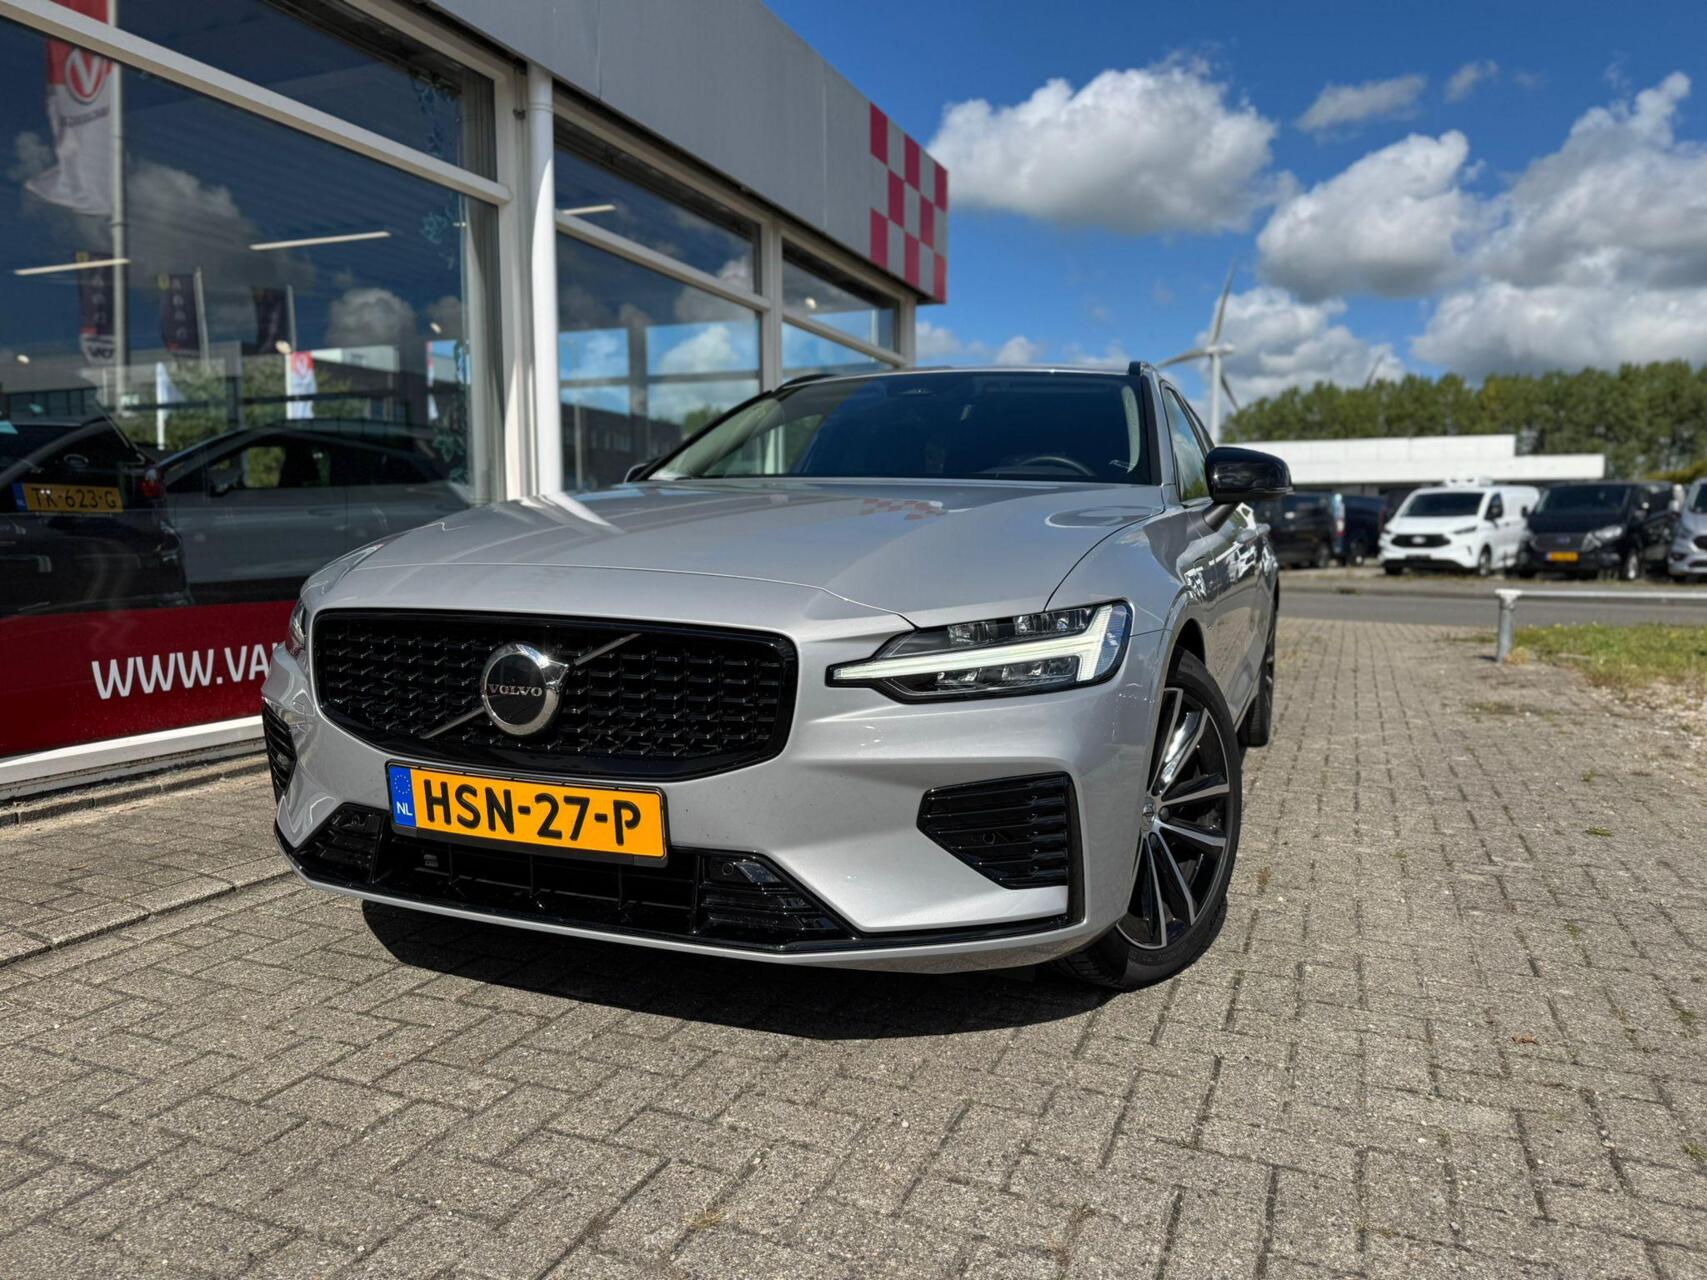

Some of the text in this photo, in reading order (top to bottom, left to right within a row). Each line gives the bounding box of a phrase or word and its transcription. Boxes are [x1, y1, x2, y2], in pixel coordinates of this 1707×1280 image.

[91, 642, 278, 700] WWW.VA
[487, 683, 543, 697] VOLVO
[396, 803, 413, 817] NL
[423, 779, 641, 846] HSN-27-P
